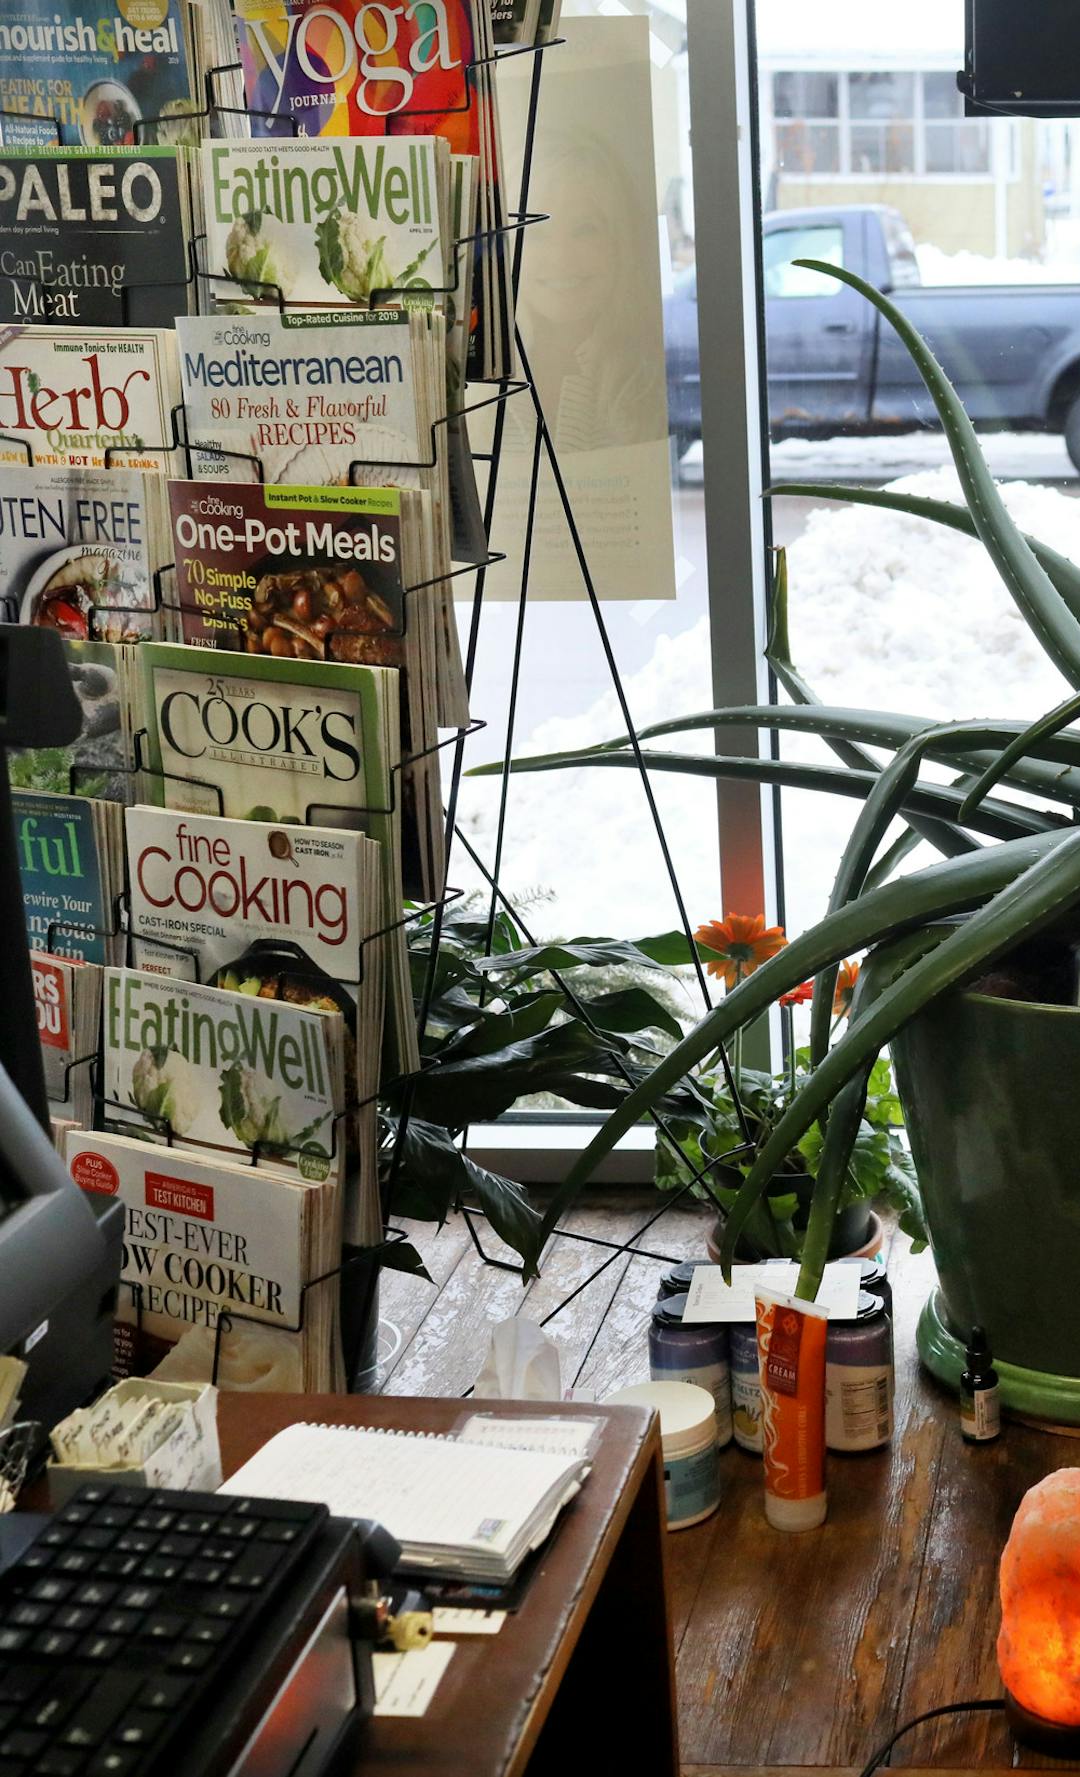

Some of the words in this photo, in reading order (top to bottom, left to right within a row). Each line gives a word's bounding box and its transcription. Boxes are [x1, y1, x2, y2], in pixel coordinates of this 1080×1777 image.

[244, 1, 461, 129] yoga
[0, 79, 45, 96] EATING
[48, 80, 72, 97] FOR
[2, 96, 85, 125] HEALTH
[37, 136, 44, 146] to
[39, 125, 58, 136] Foods
[0, 161, 162, 222] PALEO
[211, 145, 432, 225] EatingWell
[43, 226, 60, 236] living
[1, 251, 36, 276] Can
[36, 251, 126, 297] Eating
[12, 280, 81, 317] Meat
[286, 313, 332, 326] Top-Rated
[333, 313, 364, 323] Cuisine
[365, 312, 377, 321] for
[378, 311, 399, 321] 2019
[53, 342, 84, 353] Immune
[84, 342, 106, 353] Tonics
[106, 343, 118, 353] for
[118, 344, 145, 354] HEALTH
[224, 330, 271, 346] Cooking
[185, 350, 403, 387] Mediterranean
[0, 354, 151, 431] Herb
[211, 397, 231, 419] 80
[237, 396, 280, 419] Fresh
[286, 399, 300, 418] &
[307, 395, 388, 423] Flavorful
[46, 430, 136, 454] Quarterly
[257, 422, 356, 446] RECIPES
[69, 455, 89, 466] HOT
[200, 500, 244, 519] Cooking
[268, 493, 297, 502] Instant
[299, 494, 312, 503] Pot
[320, 495, 339, 504] Slow
[339, 496, 367, 505] Cooker
[76, 499, 142, 544] FREE
[175, 513, 301, 556] One-Pot
[306, 522, 396, 563] Meals
[183, 558, 205, 585] 70
[206, 568, 257, 592] Simple
[194, 589, 252, 611] No-Fuss
[201, 610, 249, 632] Dishes
[206, 678, 225, 704] 25
[225, 686, 256, 698] YEARS
[160, 692, 361, 782] COOK'S
[213, 750, 320, 772] ILLUSTRATED
[176, 823, 231, 867] fine
[294, 837, 311, 846] HOW
[311, 839, 320, 847] TO
[320, 840, 344, 850] SEASON
[295, 847, 313, 855] CAST
[313, 849, 330, 858] IRON
[62, 894, 93, 913] Your
[137, 846, 348, 946] Cooking
[138, 914, 189, 932] CAST-IRON
[190, 922, 227, 938] SPECIAL
[142, 963, 172, 975] PERFECT
[124, 977, 326, 1096] EatingWell
[85, 1157, 103, 1169] PLUS
[153, 1188, 172, 1205] TEST
[173, 1192, 206, 1214] KITCHEN
[124, 1208, 250, 1266] EST-EVER
[164, 1252, 285, 1315] COOKER
[131, 1283, 233, 1334] RECIPES
[768, 1364, 796, 1381] CREAM
